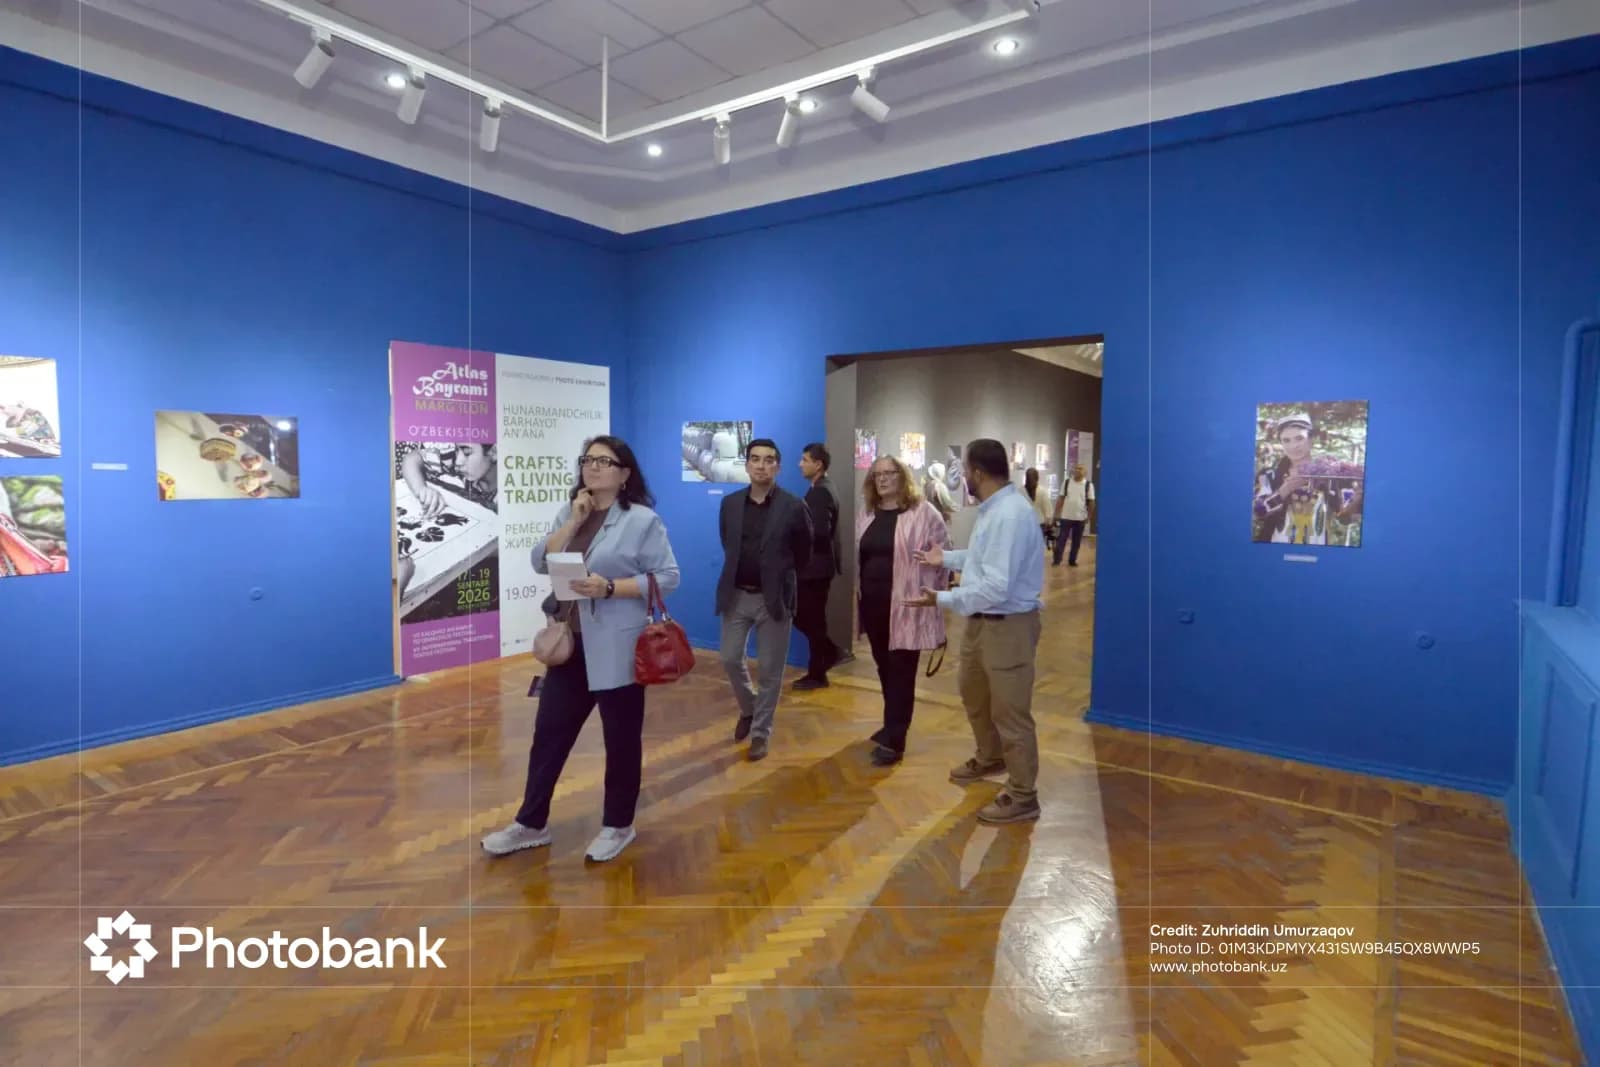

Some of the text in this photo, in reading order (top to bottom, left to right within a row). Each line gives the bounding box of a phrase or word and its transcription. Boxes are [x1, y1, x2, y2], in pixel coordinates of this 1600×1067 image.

[432, 362, 488, 380] Atlas
[412, 376, 488, 398] Bayrami
[503, 415, 557, 428] BARHAYOT
[504, 455, 568, 470] CRAFTS:
[504, 472, 574, 487] A LIVING
[504, 489, 572, 504] TRADITI
[505, 521, 551, 535] РЕМЁСЛ
[505, 536, 540, 549] ЖИВА
[480, 568, 490, 579] 19
[457, 587, 490, 604] 2026
[506, 584, 537, 600] 19.09
